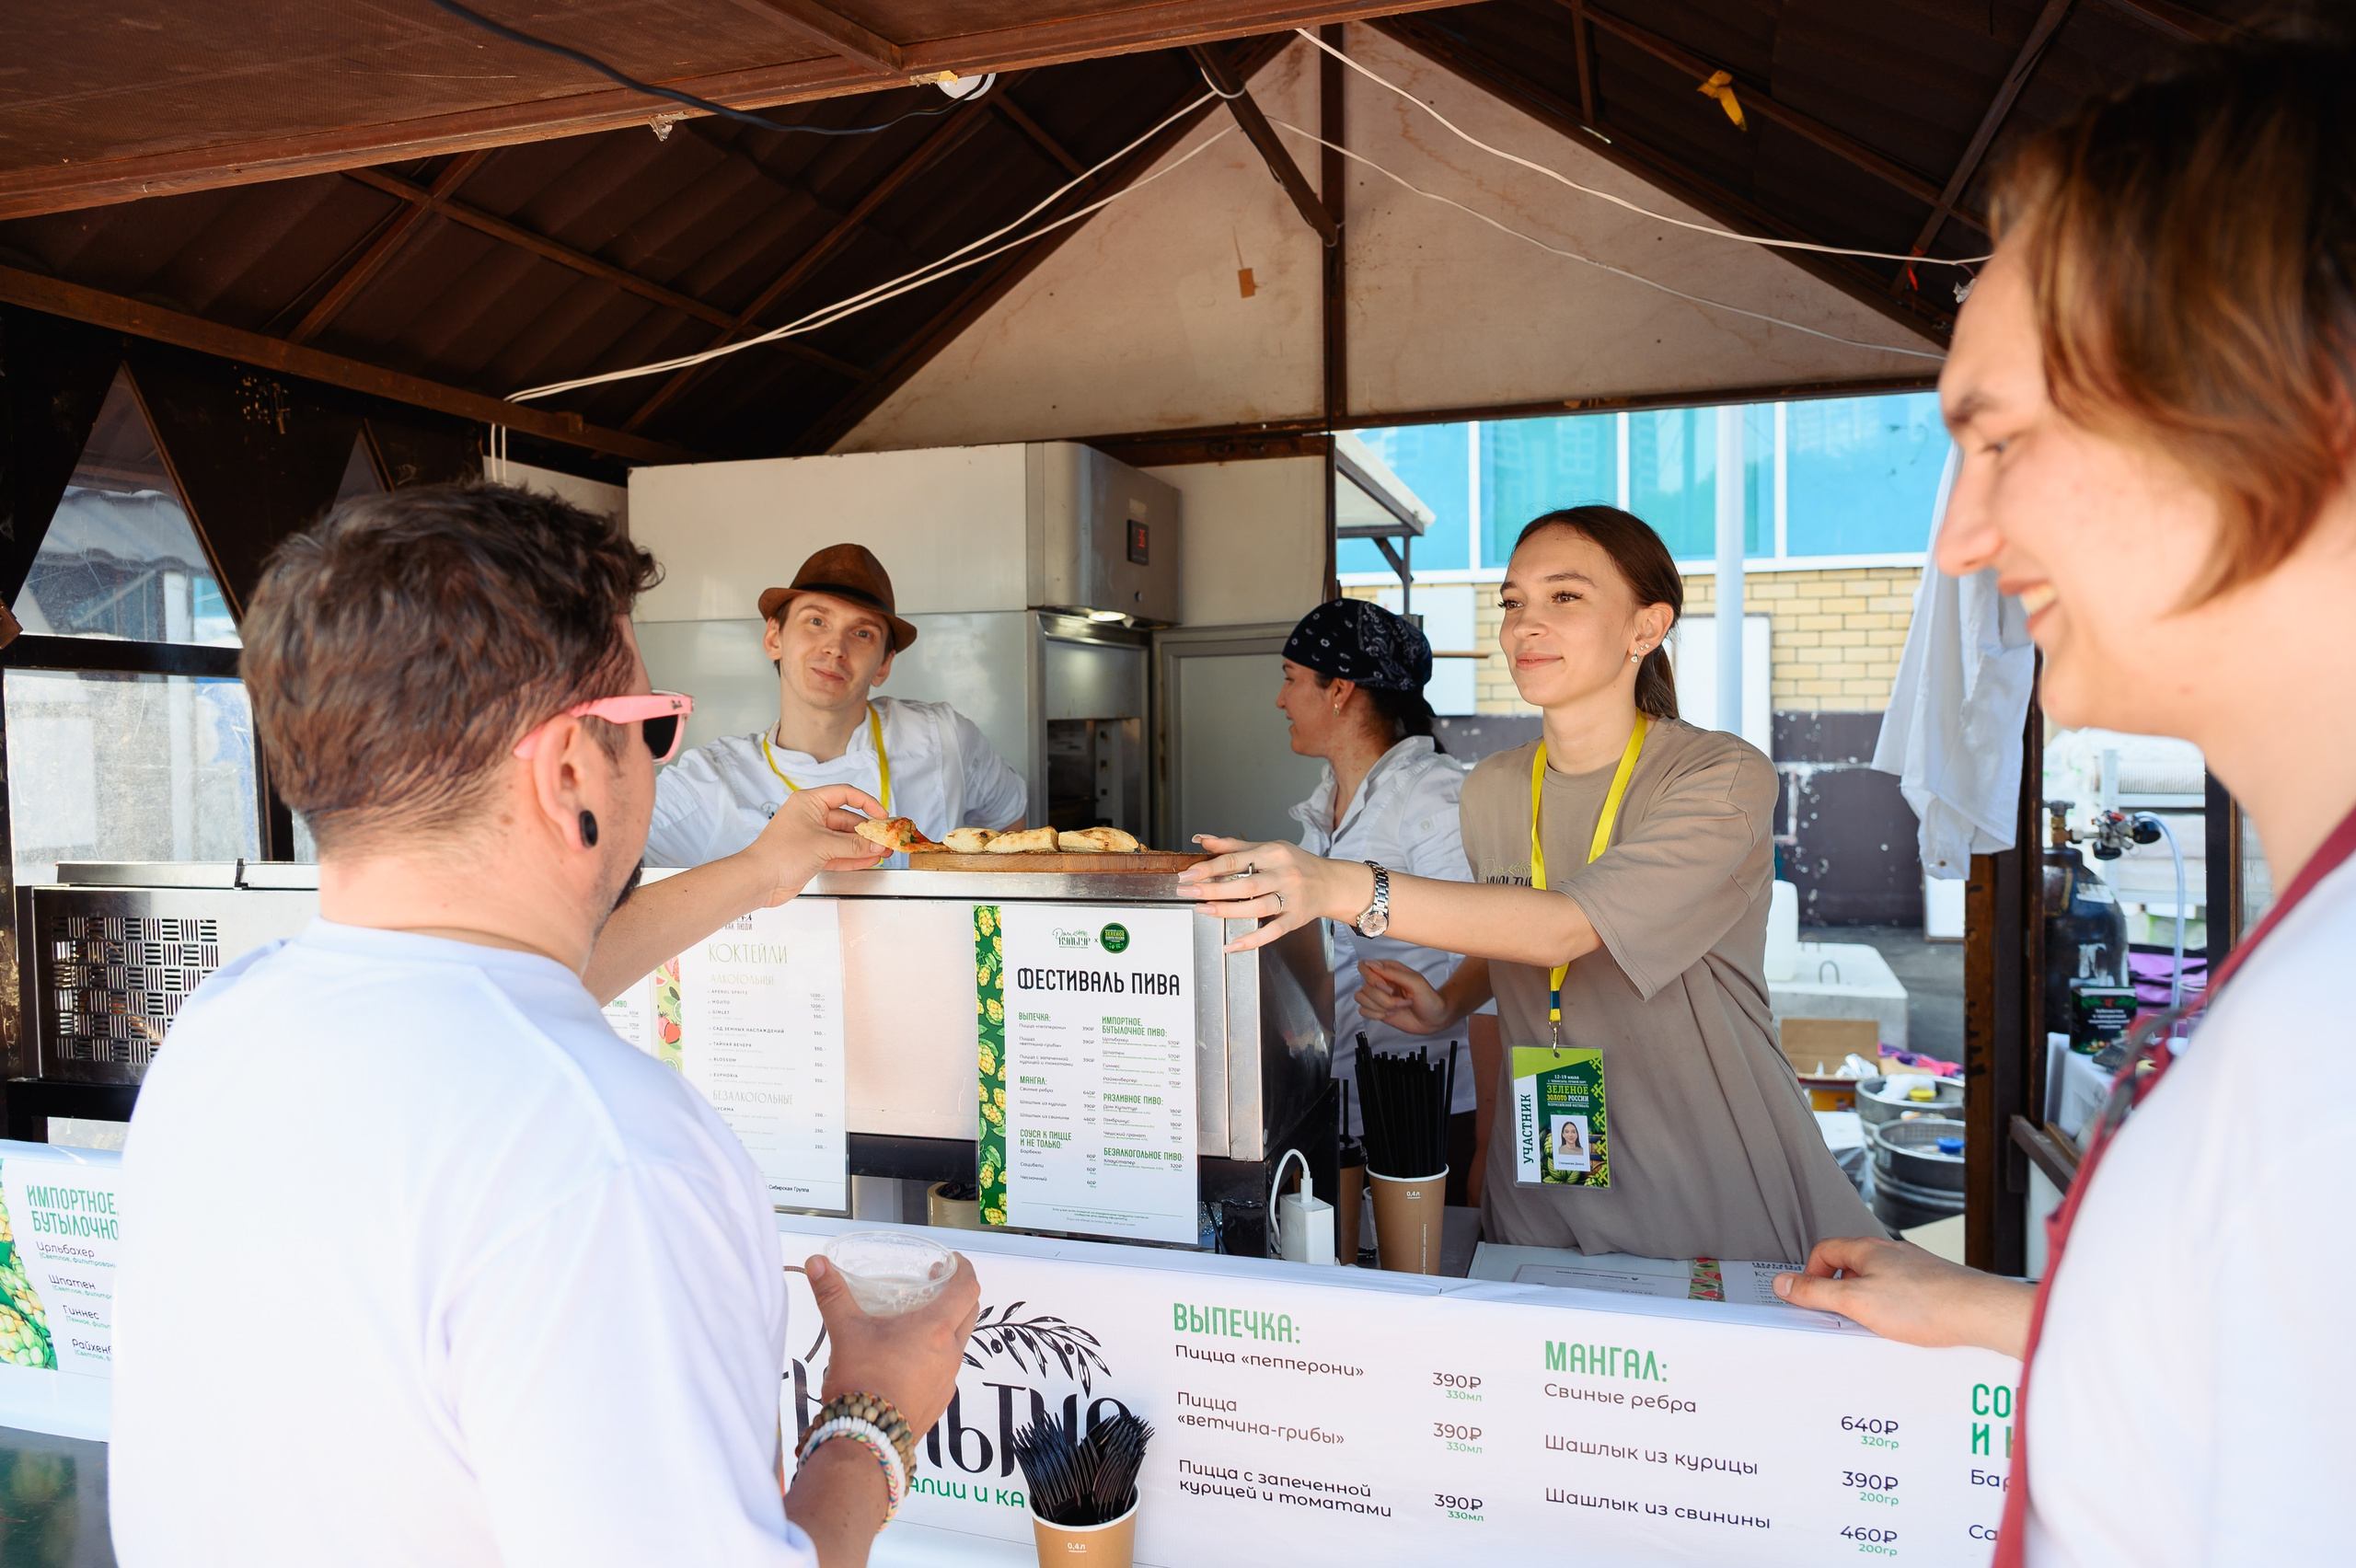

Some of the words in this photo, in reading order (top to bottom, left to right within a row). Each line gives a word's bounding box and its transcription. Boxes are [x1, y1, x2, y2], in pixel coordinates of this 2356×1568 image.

[709, 943, 787, 963] КОКТЕЙЛИ
[710, 974, 775, 986] АЛКОГОЛЬНЫЕ
[1018, 967, 1125, 993] ФЕСТИВАЛЬ
[1132, 973, 1180, 996] ПИВА
[1019, 1012, 1051, 1021] ВЫПЕЧКА:
[1103, 1025, 1145, 1035] БУТЫЛОЧНОЕ
[1148, 1028, 1167, 1037] ПИВО:
[1020, 1076, 1047, 1085] МАНГАЛ:
[1547, 1085, 1588, 1095] ЗЕЛЕНОЕ
[713, 1090, 792, 1105] БЕЗАЛКОГОЛЬНЫЕ
[1103, 1093, 1141, 1103] РАЗЛИВНОЕ
[1144, 1096, 1163, 1105] ПИВО:
[1021, 1129, 1041, 1138] СОУСА
[1049, 1132, 1072, 1141] ПИЦЦЕ
[1522, 1093, 1534, 1165] УЧАСТНИК
[1037, 1139, 1062, 1148] ТОЛЬКО:
[1103, 1147, 1161, 1159] БЕЗАЛКОГОЛЬНОЕ
[1164, 1152, 1184, 1161] ПИВО:
[31, 1210, 119, 1240] БУТЫЛОЧНО
[36, 1241, 95, 1259] Ирльбахер
[48, 1274, 96, 1290] Шпатен
[63, 1305, 99, 1320] Гиннес
[1173, 1303, 1300, 1344] ВЫПЕЧКА:
[72, 1338, 111, 1355] Райхенб
[1175, 1344, 1236, 1366] Пицца
[1241, 1353, 1364, 1378] «пепперони»
[1544, 1340, 1669, 1383] МАНГАЛ:
[1432, 1371, 1482, 1390] 390₽
[1177, 1391, 1238, 1413] Пицца
[1445, 1389, 1483, 1402] 330мл
[1543, 1382, 1625, 1406] Свиные
[1630, 1392, 1697, 1414] ребра
[1971, 1383, 2020, 1418] СО
[1177, 1412, 1345, 1447] «ветчина-грибы»
[1433, 1422, 1483, 1442] 390₽
[1841, 1415, 1900, 1435] 640₽
[1446, 1441, 1483, 1455] 330мл
[1860, 1435, 1900, 1451] 320гр
[1971, 1422, 1990, 1456] И
[1544, 1434, 1639, 1461] Шашлык
[1644, 1446, 1669, 1464] из
[1674, 1452, 1759, 1477] курицы
[1179, 1458, 1239, 1482] Пицца
[1243, 1469, 1253, 1482] с
[1258, 1470, 1371, 1498] запеченной
[1842, 1470, 1899, 1492] 390₽
[1971, 1470, 2011, 1492] Бар
[908, 1477, 966, 1500] АЛИИ
[974, 1486, 988, 1503] И
[996, 1489, 1025, 1508] КА
[1179, 1481, 1257, 1501] курицей
[1262, 1488, 1274, 1502] и
[1278, 1491, 1392, 1517] томатами
[1859, 1491, 1900, 1507] 200гр
[1434, 1493, 1484, 1512] 390₽
[1544, 1487, 1639, 1515] Шашлык
[1644, 1500, 1669, 1517] из
[1674, 1504, 1771, 1530] свинины
[1448, 1510, 1484, 1522] 330мл
[1840, 1524, 1899, 1544] 460₽
[1969, 1524, 1998, 1541] Са
[1068, 1542, 1086, 1551] 0,4л
[1857, 1543, 1899, 1559] 200гр
